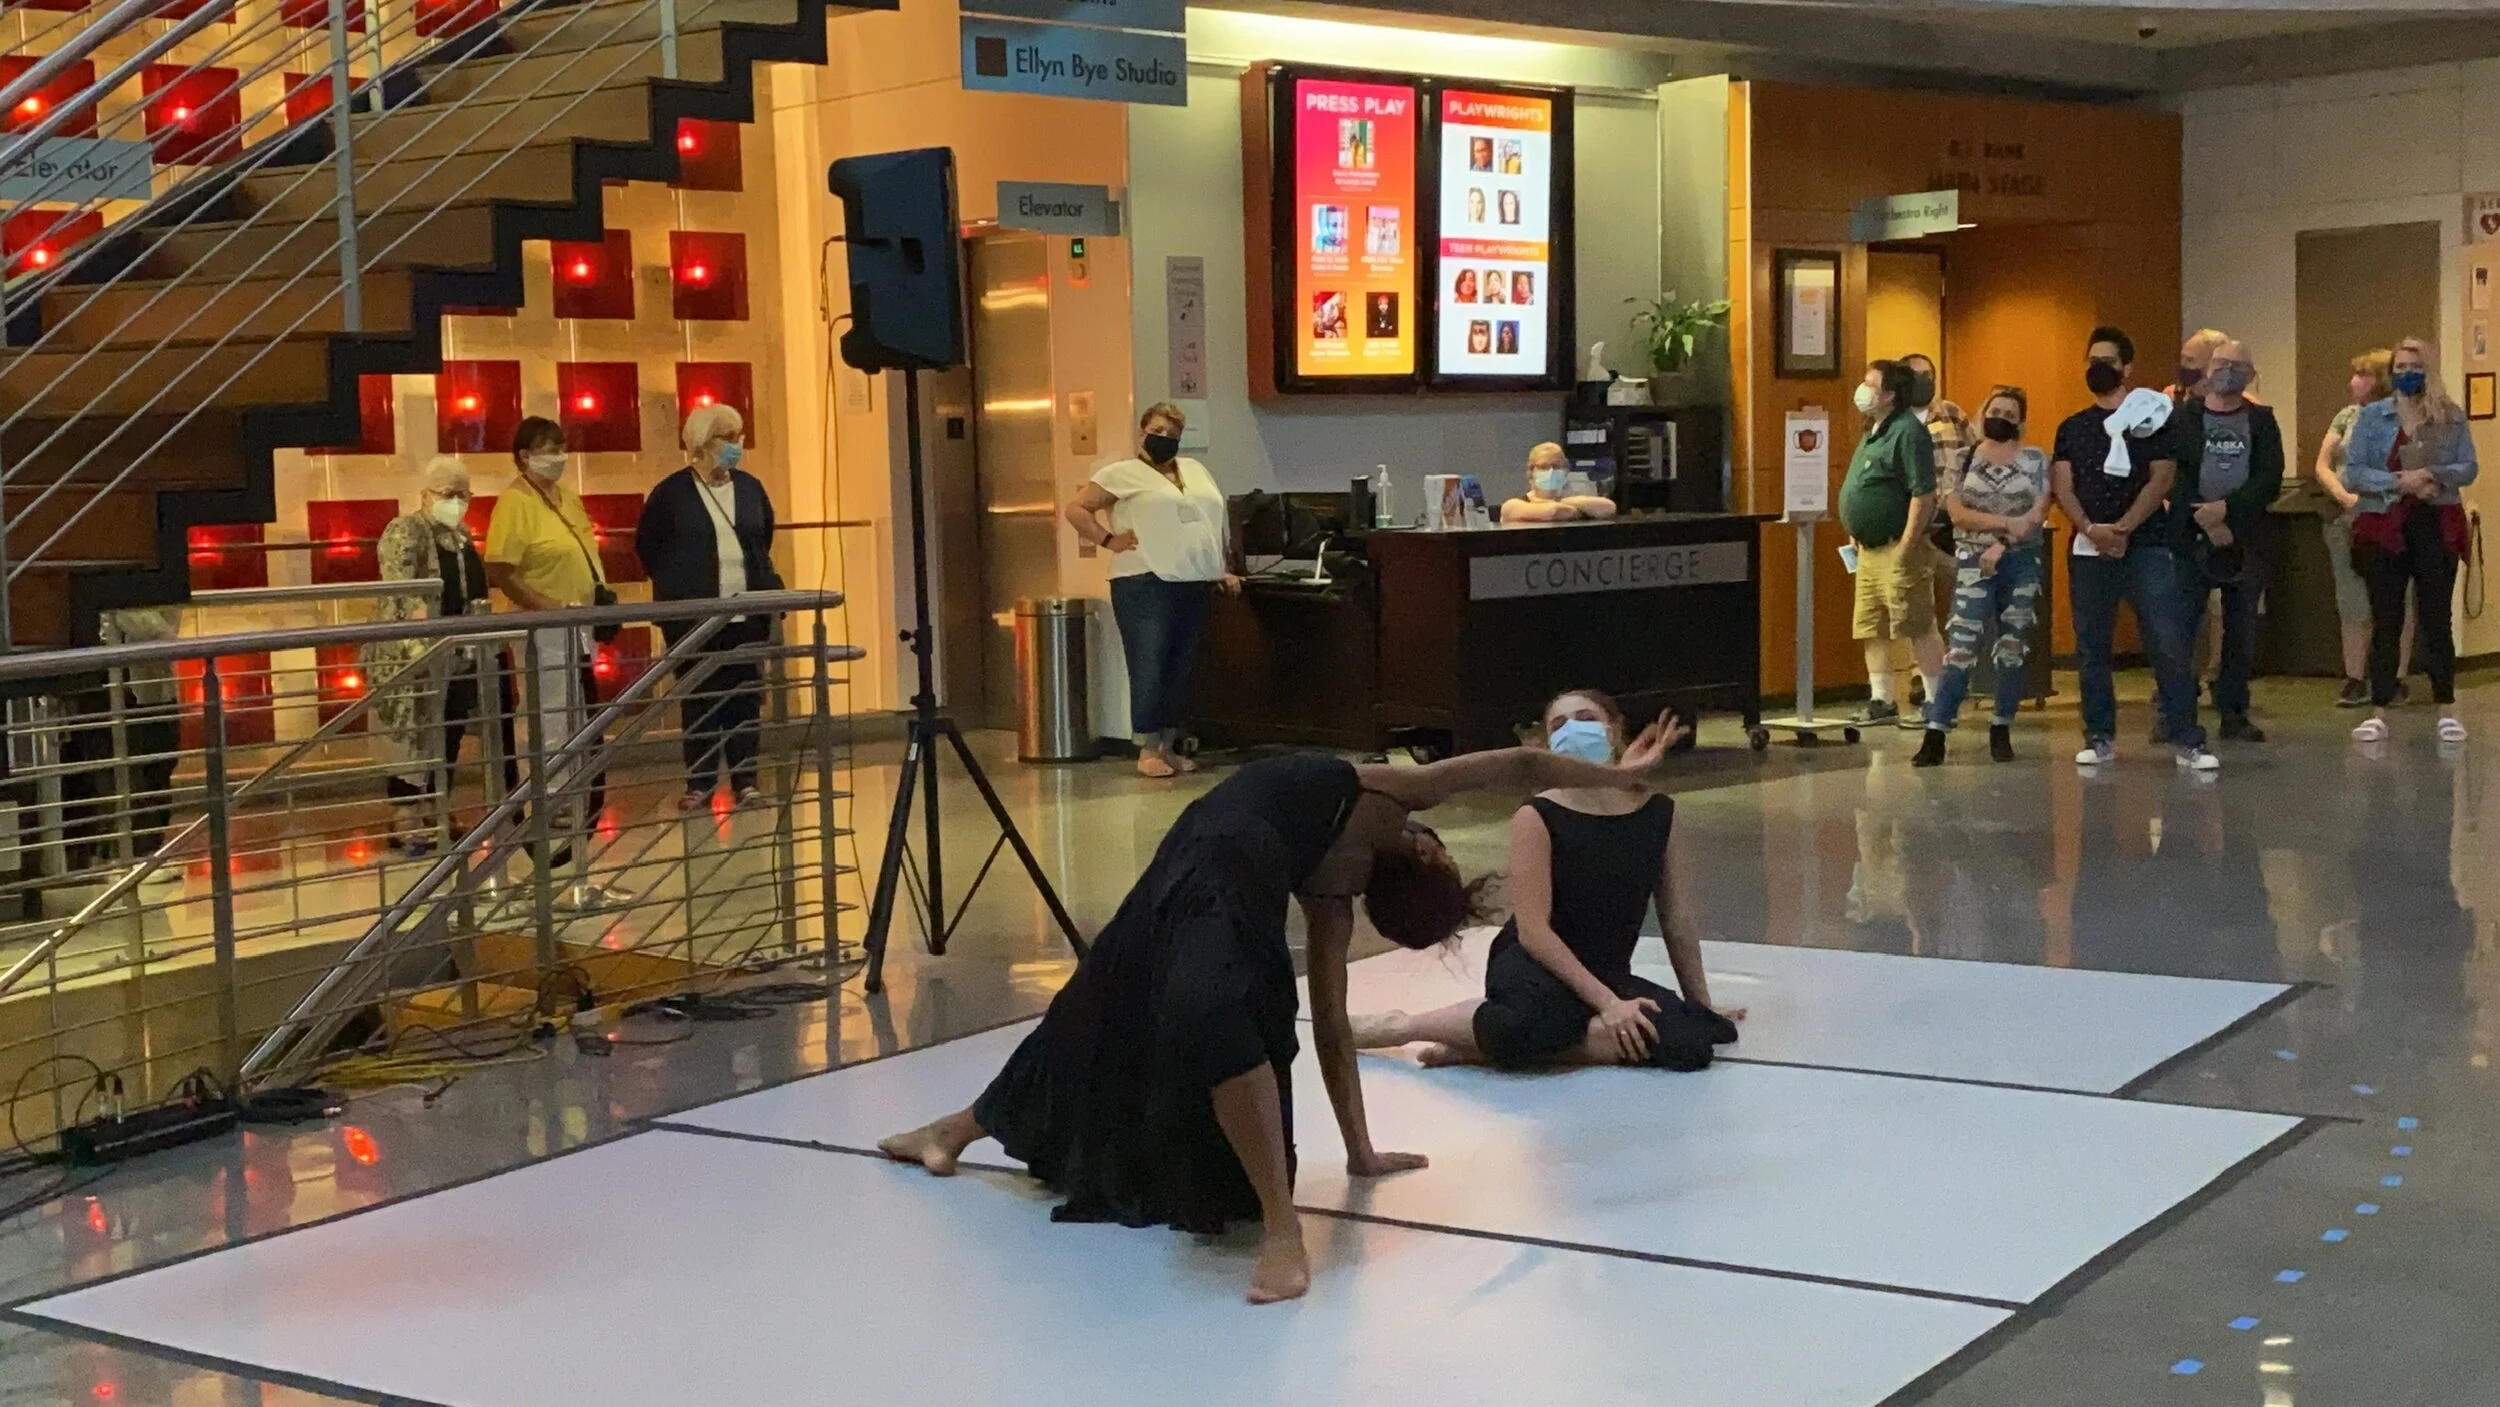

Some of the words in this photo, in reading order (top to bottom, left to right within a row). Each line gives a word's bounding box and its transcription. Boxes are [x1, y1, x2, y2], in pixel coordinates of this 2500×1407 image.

[1016, 46, 1064, 82] Ellyn
[1072, 53, 1108, 86] Bye
[1116, 58, 1177, 86] Studio
[1306, 93, 1359, 113] PRESS
[1364, 97, 1406, 116] PLAY
[1449, 100, 1544, 122] PLAYWRIGHTS
[1019, 194, 1084, 217] Elevator
[1924, 203, 1949, 219] Right
[1525, 551, 1705, 589] CONCIERGE
